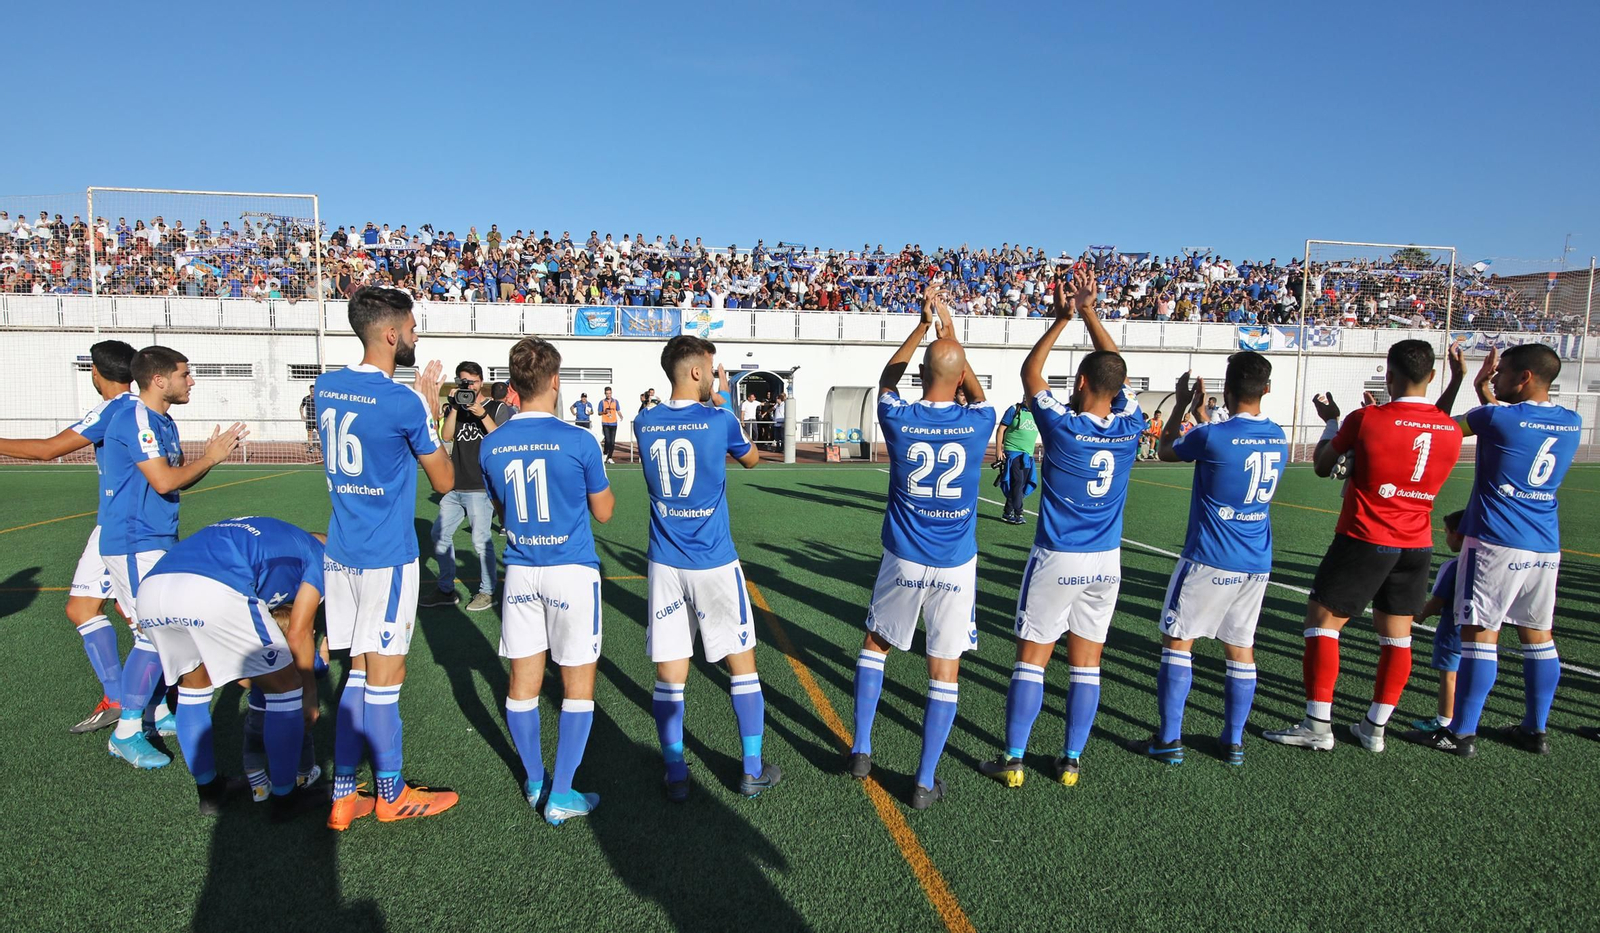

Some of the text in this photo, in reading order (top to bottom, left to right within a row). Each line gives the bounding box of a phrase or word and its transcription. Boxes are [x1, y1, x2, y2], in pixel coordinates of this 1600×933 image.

[323, 391, 377, 405] CAPILAR ERCILLA
[646, 422, 709, 433] CAPILAR ERCILLA
[908, 426, 975, 435] CAPILAR ERCILLA
[1082, 435, 1110, 445] CAPILAR
[1402, 420, 1456, 432] CAPILAR ERCILLA
[1527, 422, 1580, 433] CAPILAR ERCILLA
[320, 407, 363, 477] 16
[498, 443, 560, 454] CAPILAR ERCILLA
[1410, 431, 1433, 483] 1
[650, 438, 696, 498] 19
[906, 441, 967, 500] 22
[1086, 450, 1116, 498] 3
[1527, 436, 1559, 487] 6
[334, 482, 385, 496] okitchen
[503, 458, 551, 523] 11
[1243, 451, 1282, 505] 15
